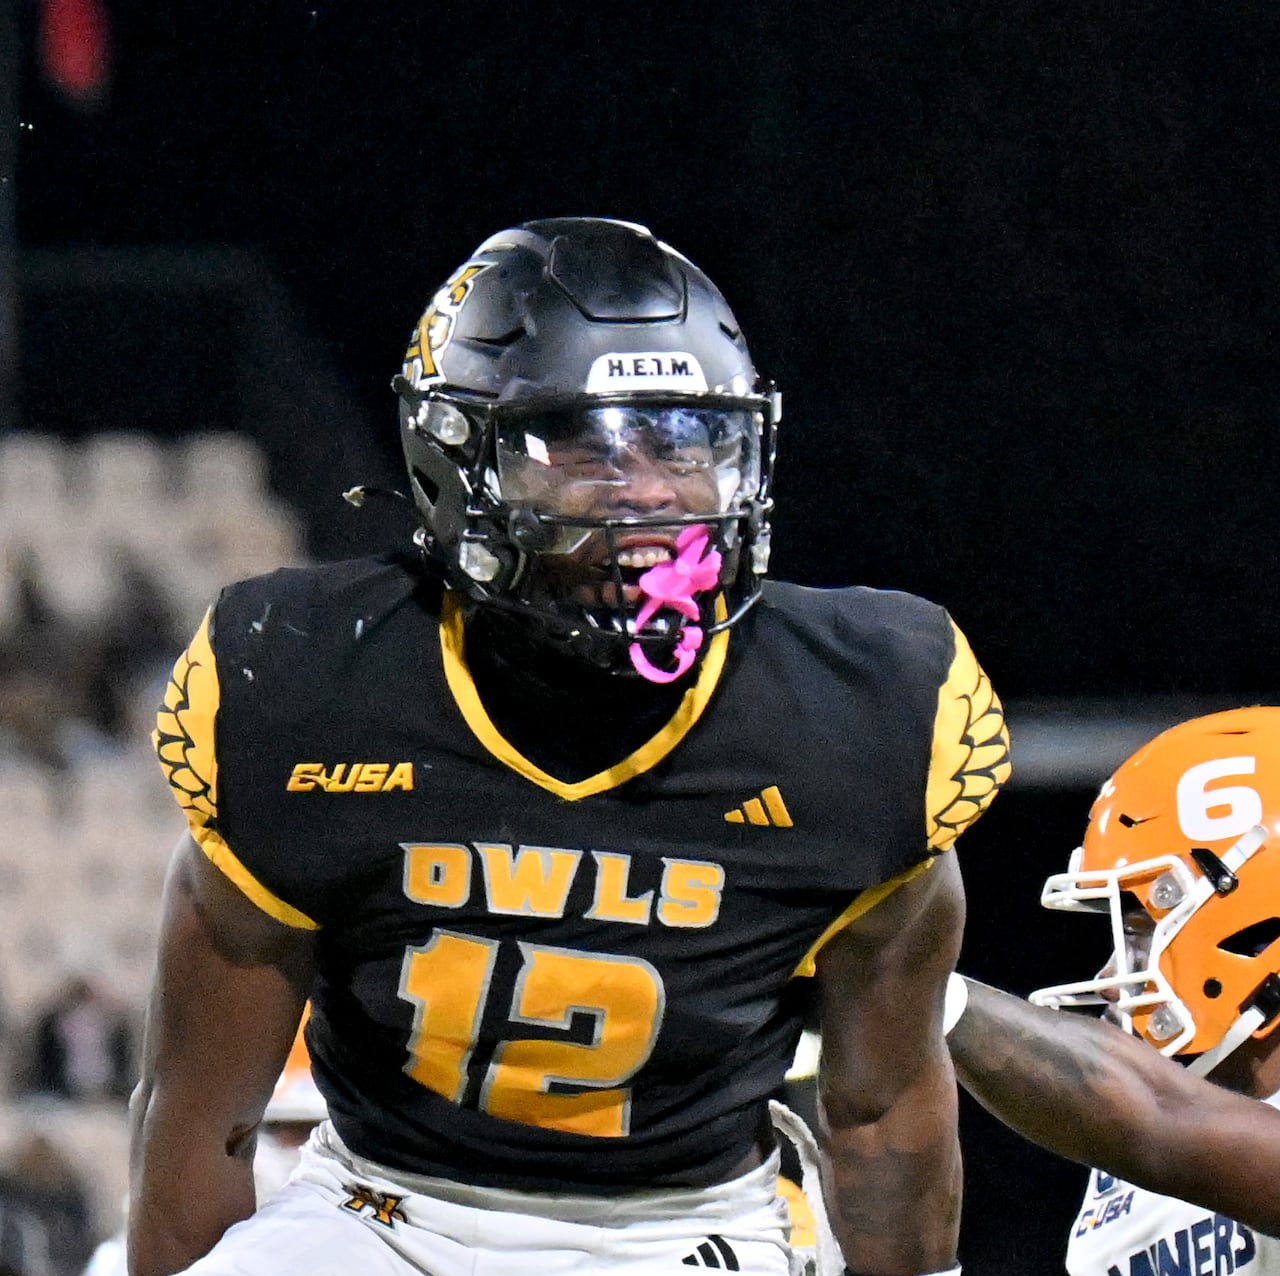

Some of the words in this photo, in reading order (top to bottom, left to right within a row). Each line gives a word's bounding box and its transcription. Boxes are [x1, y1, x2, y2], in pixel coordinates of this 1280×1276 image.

[1176, 756, 1263, 842] 6
[399, 842, 726, 929] OWLS
[397, 926, 667, 1138] 12
